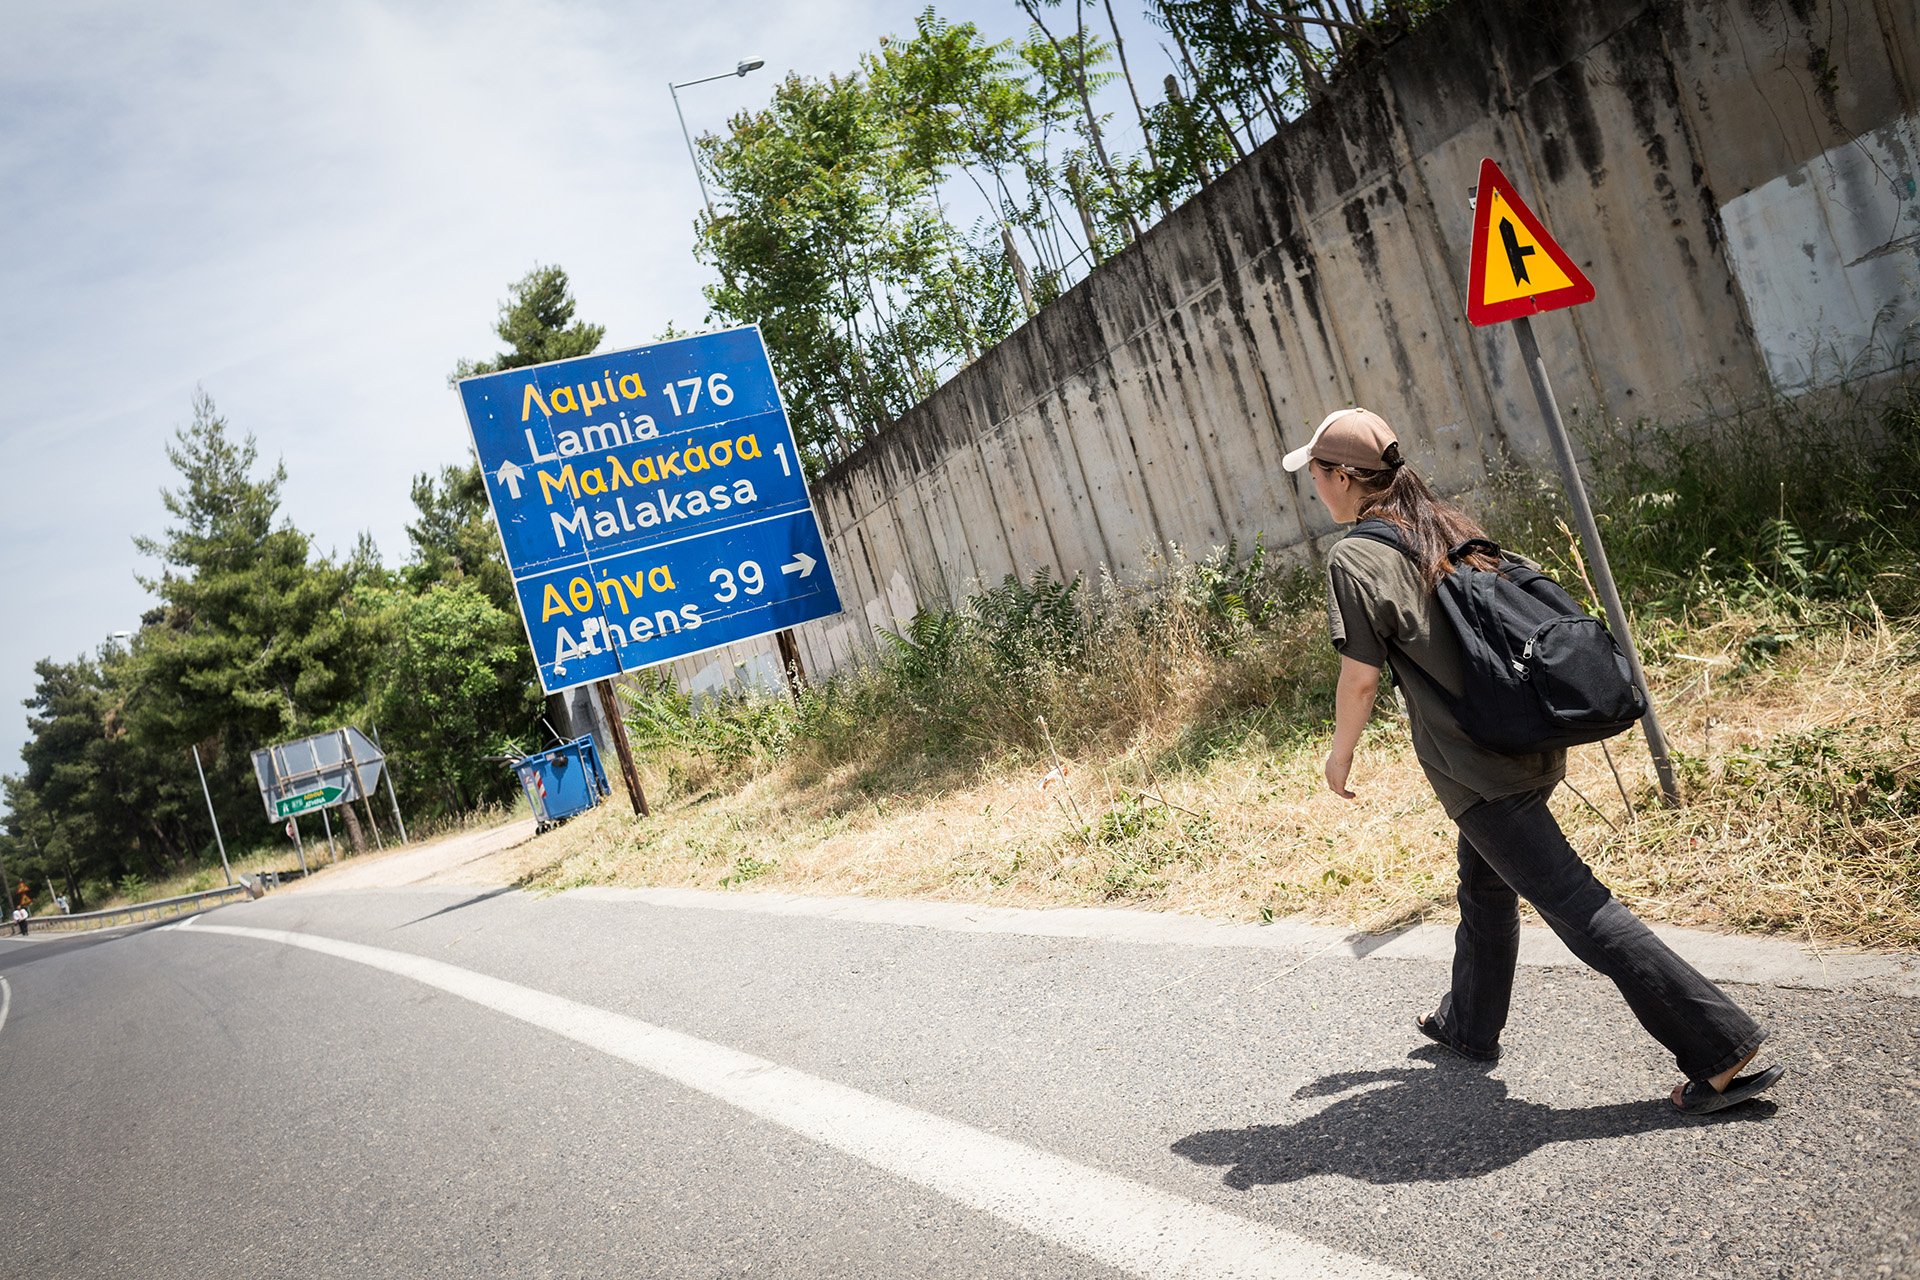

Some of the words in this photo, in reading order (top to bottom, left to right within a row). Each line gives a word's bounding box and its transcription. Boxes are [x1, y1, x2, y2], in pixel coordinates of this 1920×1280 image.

[522, 371, 647, 422] Λαμία
[662, 373, 734, 417] 176
[524, 411, 659, 463] Lamia
[773, 442, 791, 477] 1
[537, 432, 762, 505] Μαλακάσα
[550, 479, 758, 548] Malakasa
[541, 565, 676, 623] Αθήνα
[709, 560, 765, 603] 39
[554, 603, 703, 667] Athens
